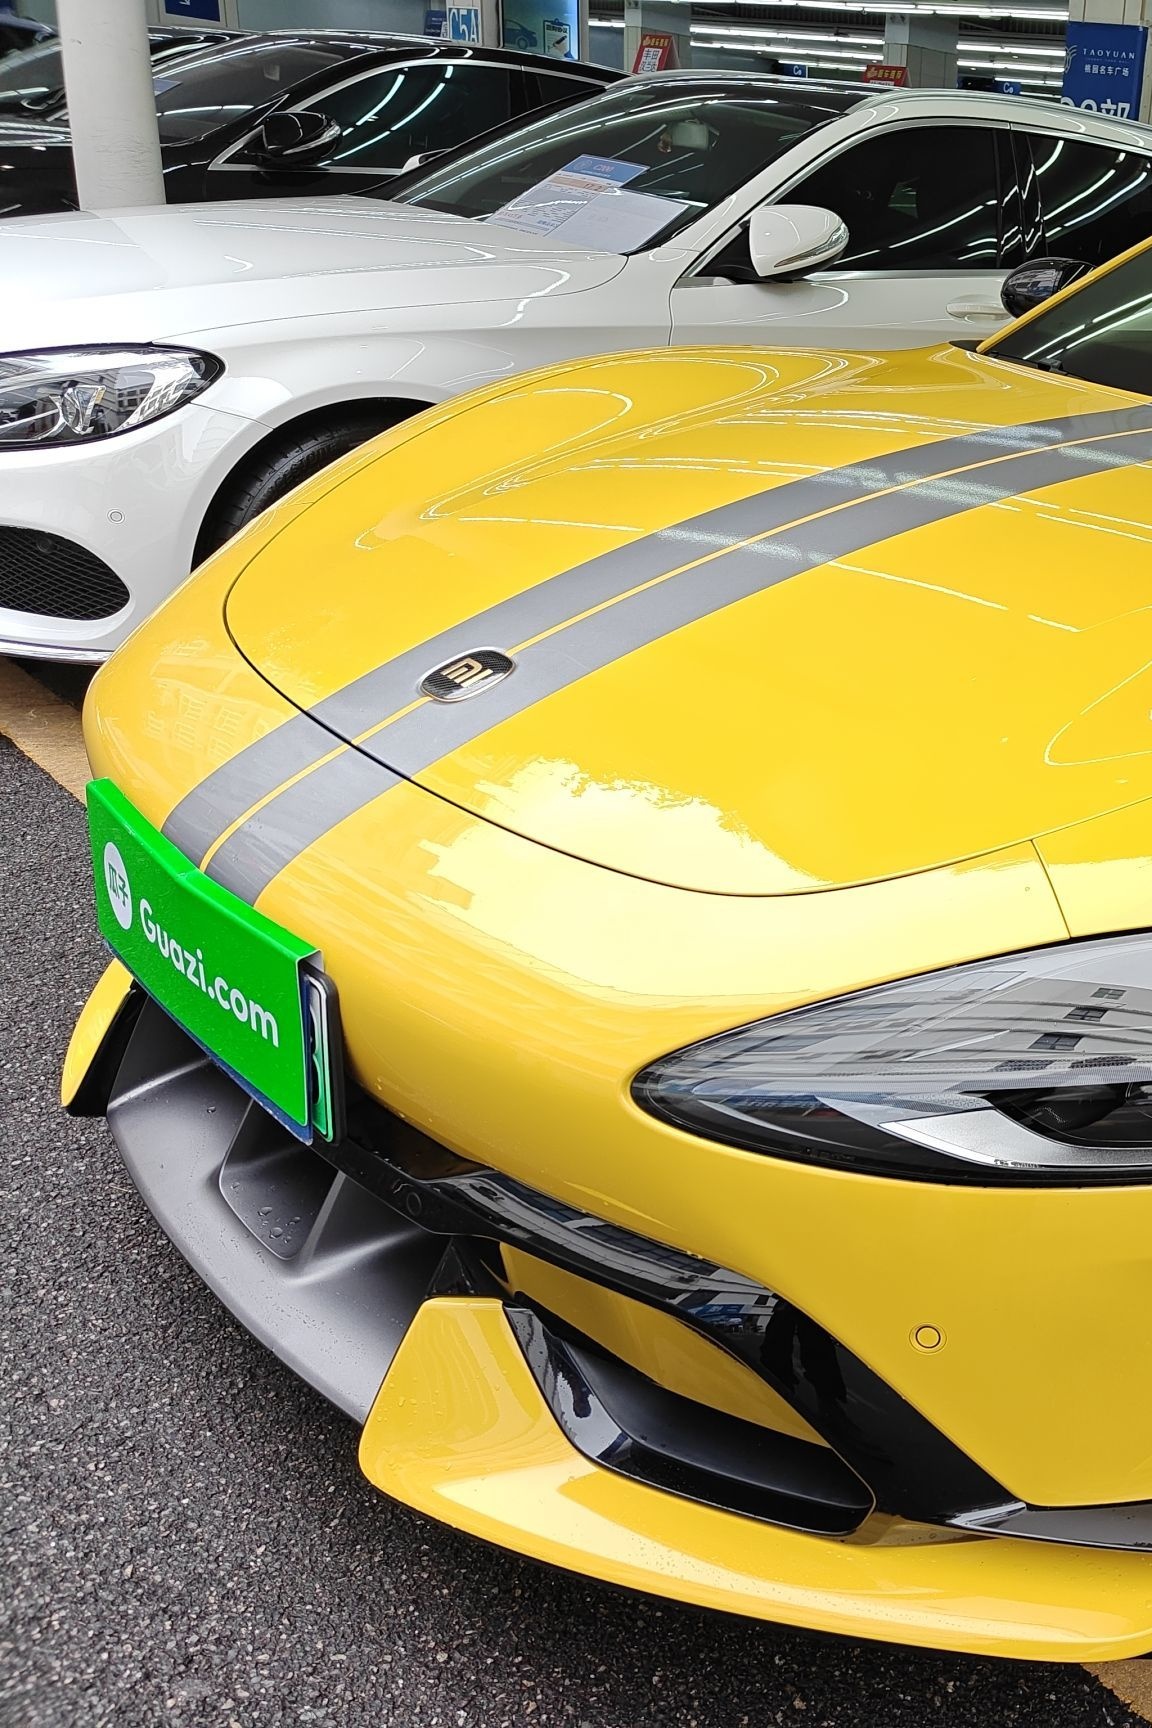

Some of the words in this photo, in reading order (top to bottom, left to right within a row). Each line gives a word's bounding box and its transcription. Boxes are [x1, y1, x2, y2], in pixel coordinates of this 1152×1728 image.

[449, 8, 478, 43] C5A
[1083, 48, 1135, 60] TAOYUAN
[1084, 63, 1130, 77] 桃园名车广场
[107, 861, 129, 908] 瓜子
[139, 897, 280, 1049] Guazi.com
